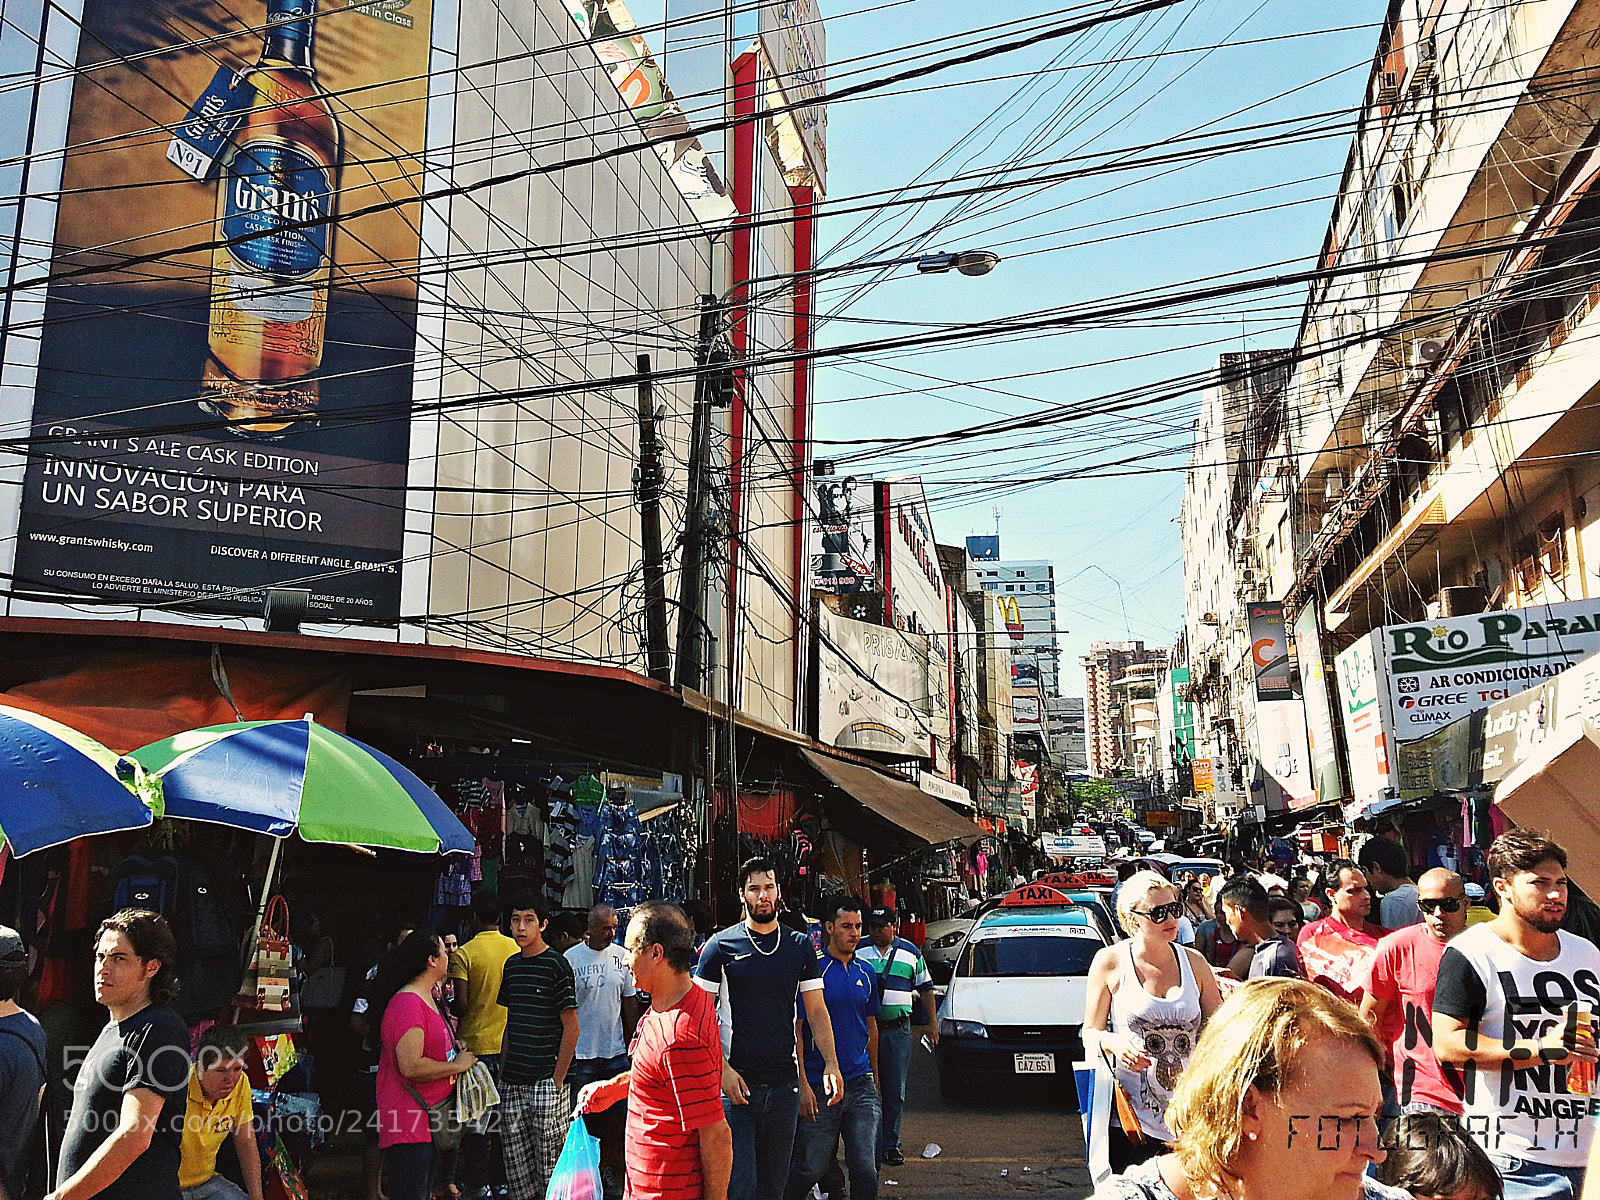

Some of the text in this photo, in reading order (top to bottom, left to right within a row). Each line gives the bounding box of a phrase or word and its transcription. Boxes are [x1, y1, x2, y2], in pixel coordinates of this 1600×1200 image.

[384, 11, 412, 26] Class
[48, 425, 320, 476] GRANTS ALE CASK EDITION
[43, 453, 306, 506] INNOVACIÓN PARA
[42, 481, 323, 532] UN SABOR SUPERIOR
[29, 532, 154, 553] www.grantswhisky.com
[210, 544, 260, 560] DISCOVER
[260, 552, 268, 560] A
[270, 551, 320, 566] DIFFERENT
[320, 557, 353, 570] ANGLE.
[43, 568, 55, 576] SU
[56, 570, 96, 580] CONSUMO
[97, 574, 109, 582] EN
[110, 574, 141, 584] EXCESO
[142, 576, 163, 586] DAÑA
[164, 579, 174, 588] LA
[92, 581, 102, 589] LO
[104, 582, 142, 592] ADVIERTE
[142, 586, 152, 594] EL
[153, 586, 196, 598] MINISTERIO
[336, 596, 345, 604] DE
[1478, 614, 1600, 649] PARA
[1430, 675, 1452, 689] AR
[1418, 692, 1468, 707] GREE
[1044, 875, 1080, 884] TAXI
[1016, 888, 1053, 900] TAXI
[1018, 1060, 1050, 1071] CAZ 651
